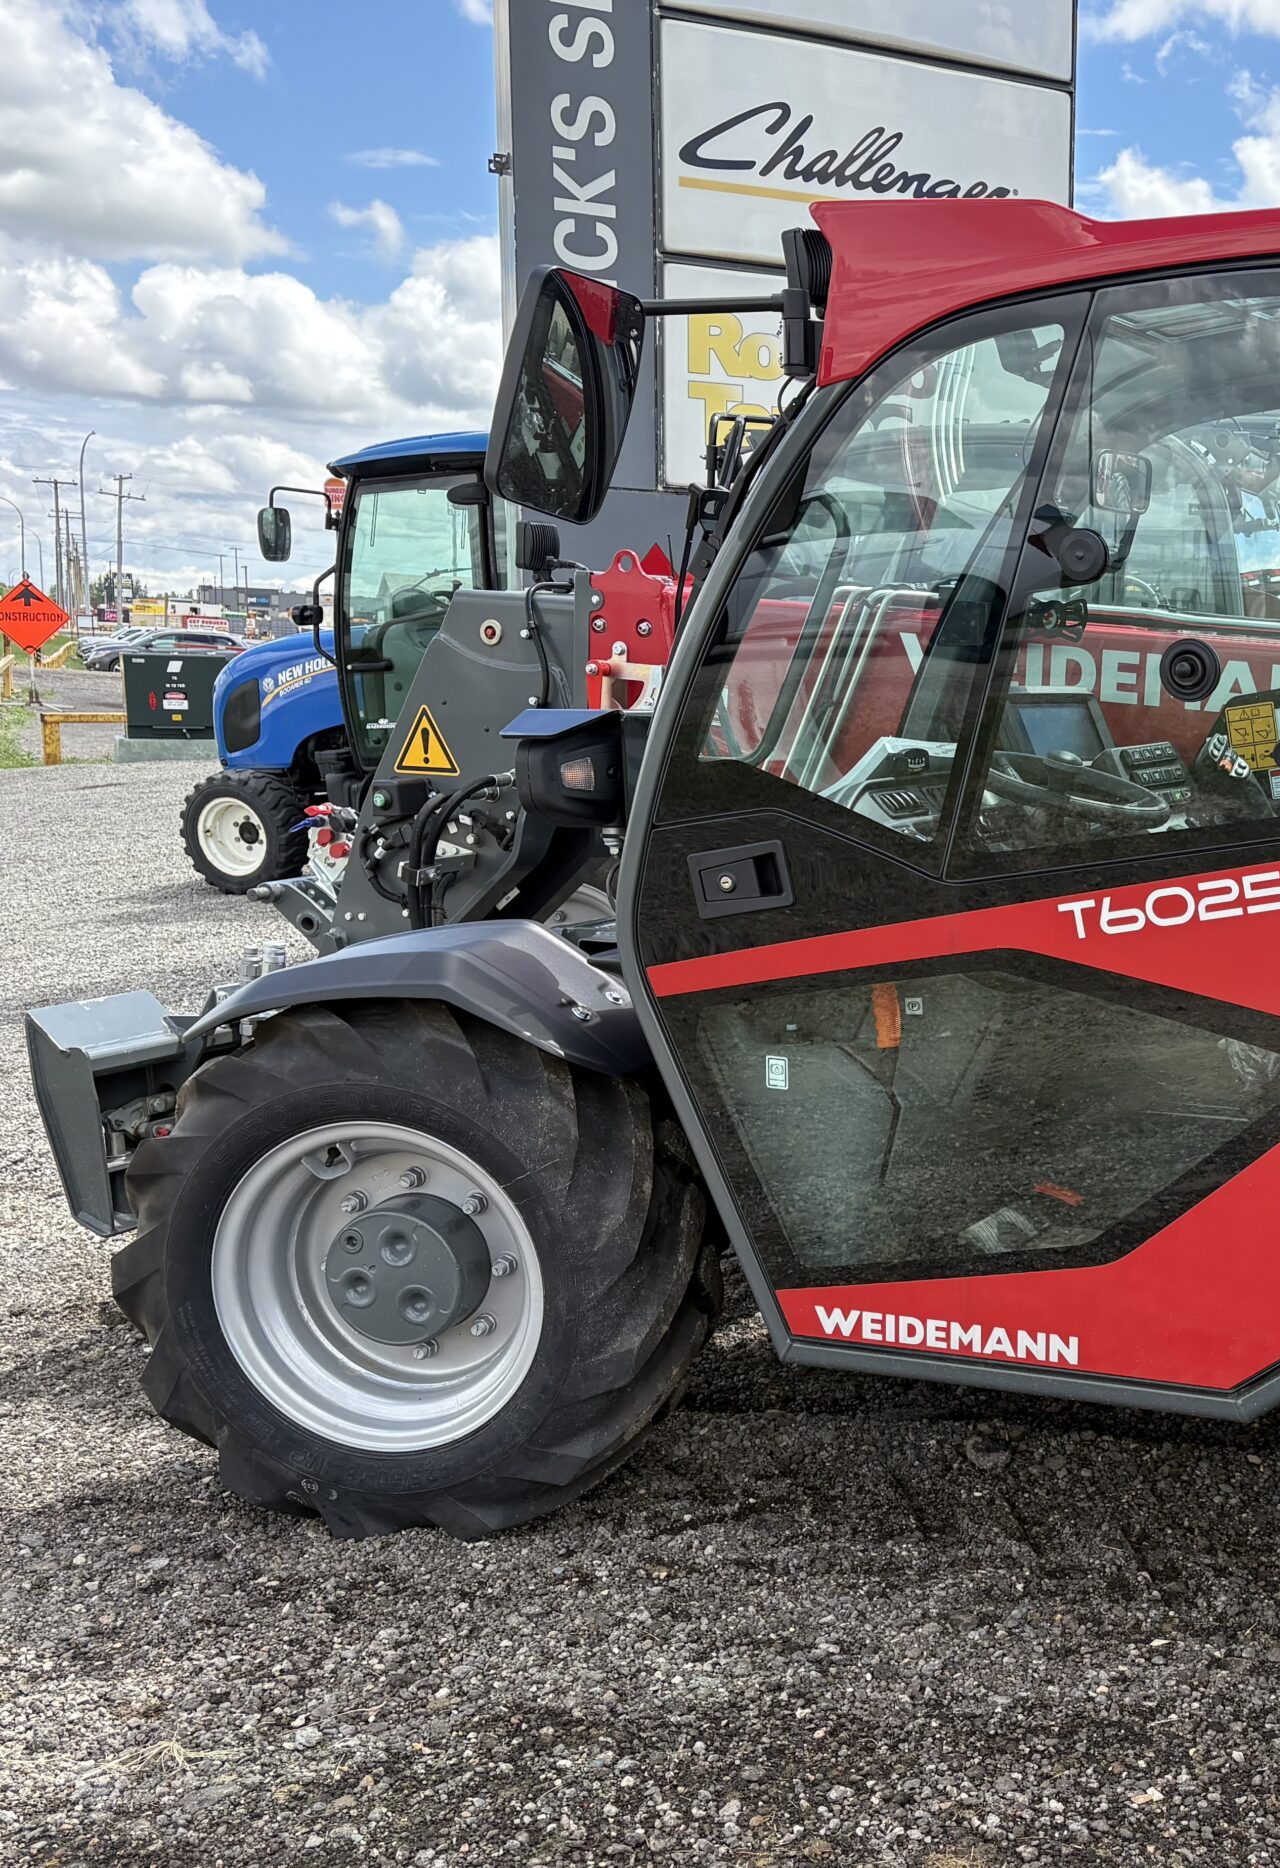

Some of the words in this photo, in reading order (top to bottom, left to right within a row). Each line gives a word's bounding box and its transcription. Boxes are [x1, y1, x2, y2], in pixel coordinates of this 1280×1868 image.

[548, 0, 615, 68] S
[550, 93, 619, 288] CK'S
[0, 611, 63, 622] ONSTRUCTION
[278, 665, 303, 685] NEW
[814, 1305, 1079, 1366] WEIDEMANN
